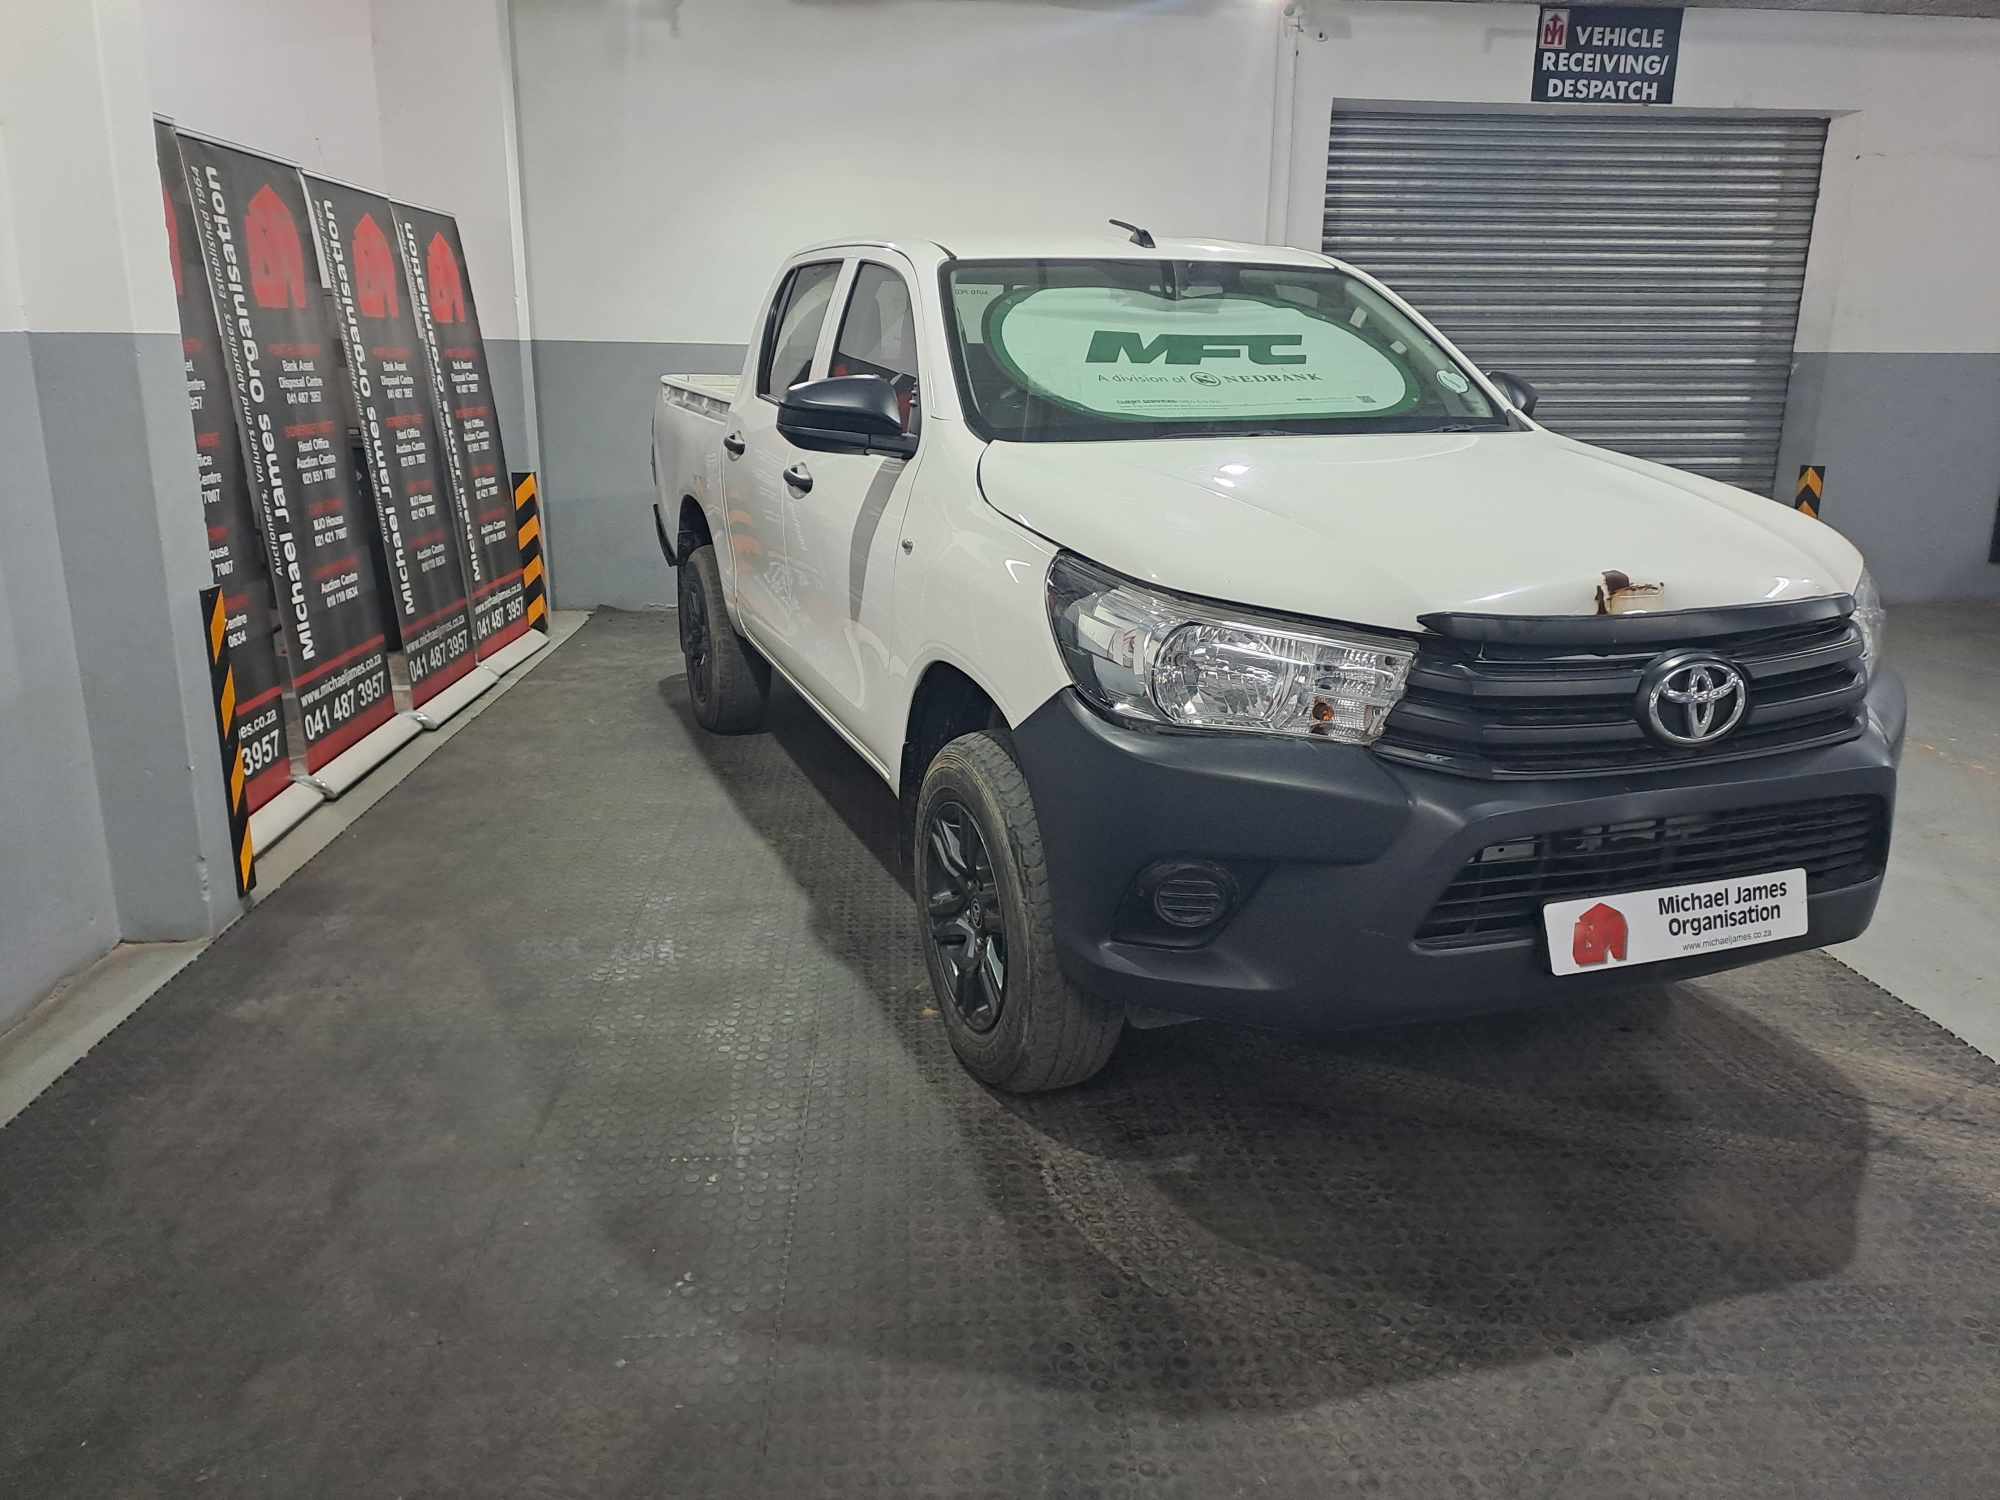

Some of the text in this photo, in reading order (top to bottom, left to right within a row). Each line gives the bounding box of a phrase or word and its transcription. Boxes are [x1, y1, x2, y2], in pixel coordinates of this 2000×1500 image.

[1576, 26, 1665, 48] VEHICLE
[1542, 52, 1669, 75] RECEIVING/
[1547, 79, 1658, 100] DESPATCH
[201, 209, 226, 298] Established
[206, 166, 265, 403] Organisation
[1085, 330, 1307, 365] MFC
[1098, 372, 1323, 384] A division of NEDBANK
[240, 395, 253, 425] and
[324, 200, 415, 615] Michael James Organisation
[258, 414, 290, 523] James
[458, 487, 480, 581] Michael
[209, 545, 229, 560] ouse
[279, 531, 315, 660] Michael
[476, 596, 524, 640] 041 487 3957
[409, 629, 468, 682] 041 487 3957
[304, 670, 384, 740] 041 487 3957
[238, 709, 277, 739] es.co.za
[241, 728, 280, 776] 3957
[1658, 880, 1788, 916] Michael James
[1668, 904, 1782, 937] Organisation
[1682, 928, 1773, 952] www.michaeljames.co.za
